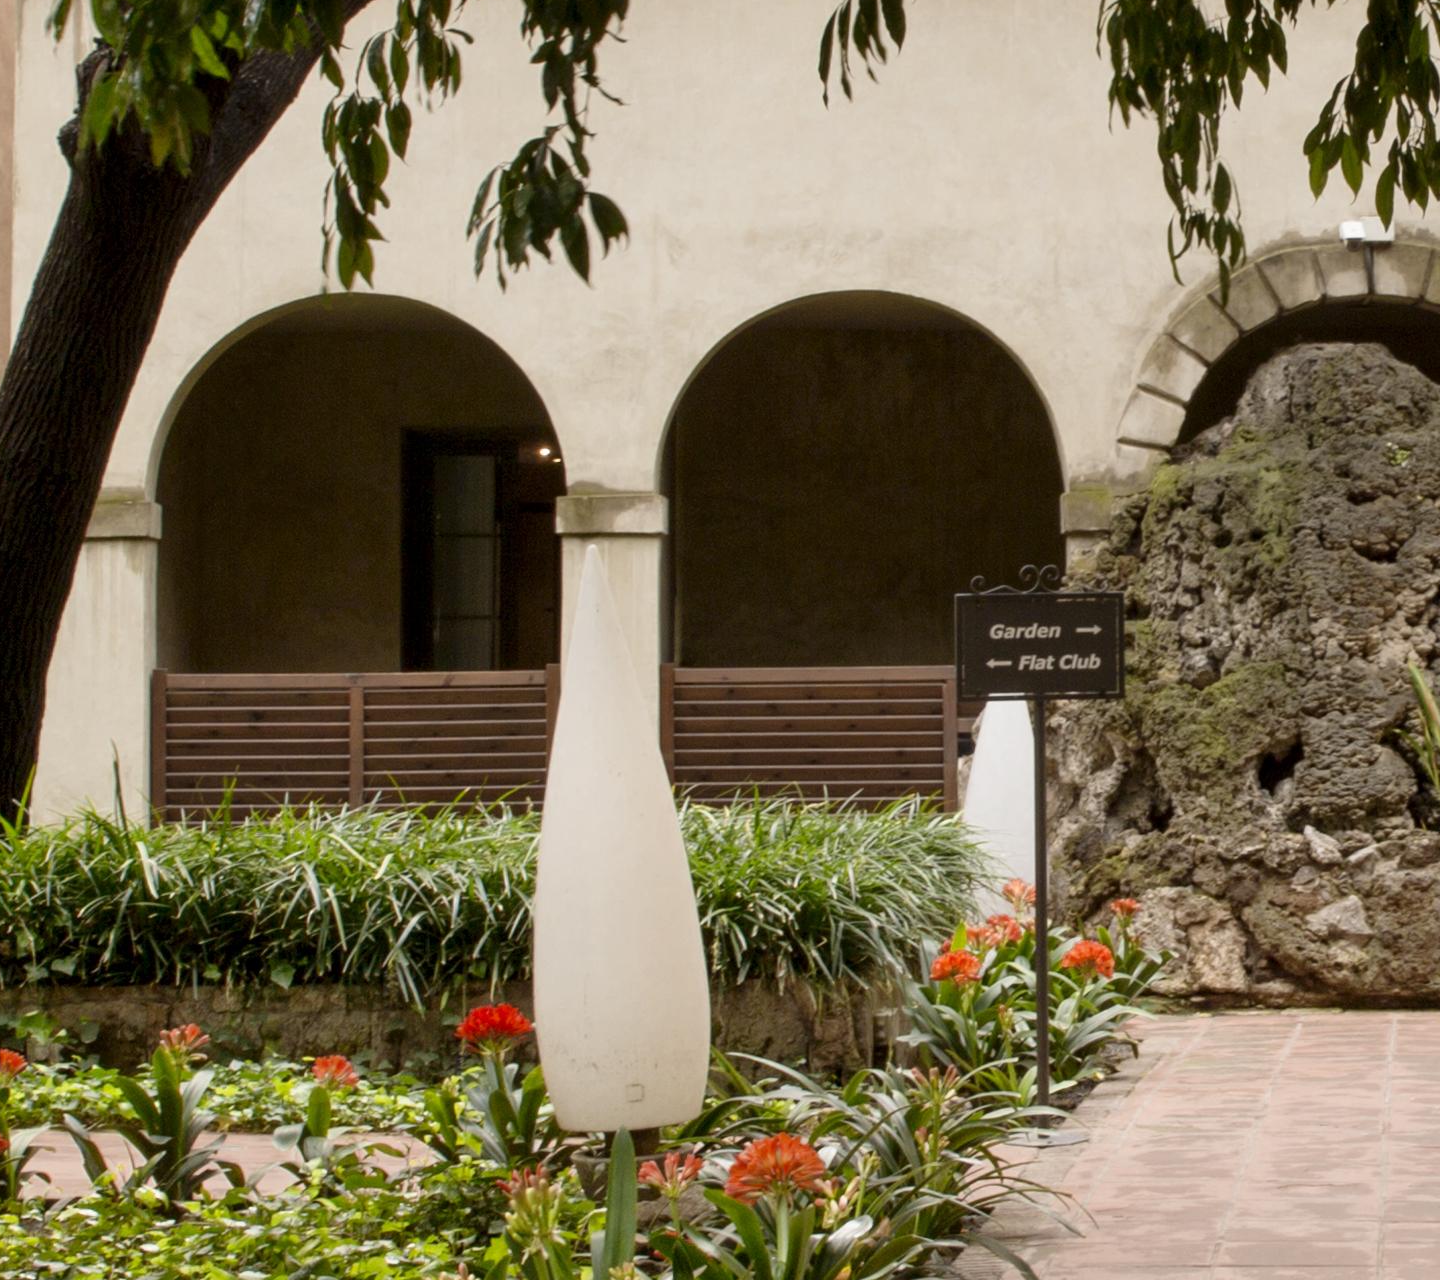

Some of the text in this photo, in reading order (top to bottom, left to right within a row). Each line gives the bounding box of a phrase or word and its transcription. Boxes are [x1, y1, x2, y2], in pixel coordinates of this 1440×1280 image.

[989, 622, 1062, 639] Garden
[1018, 653, 1101, 670] Flat Club
